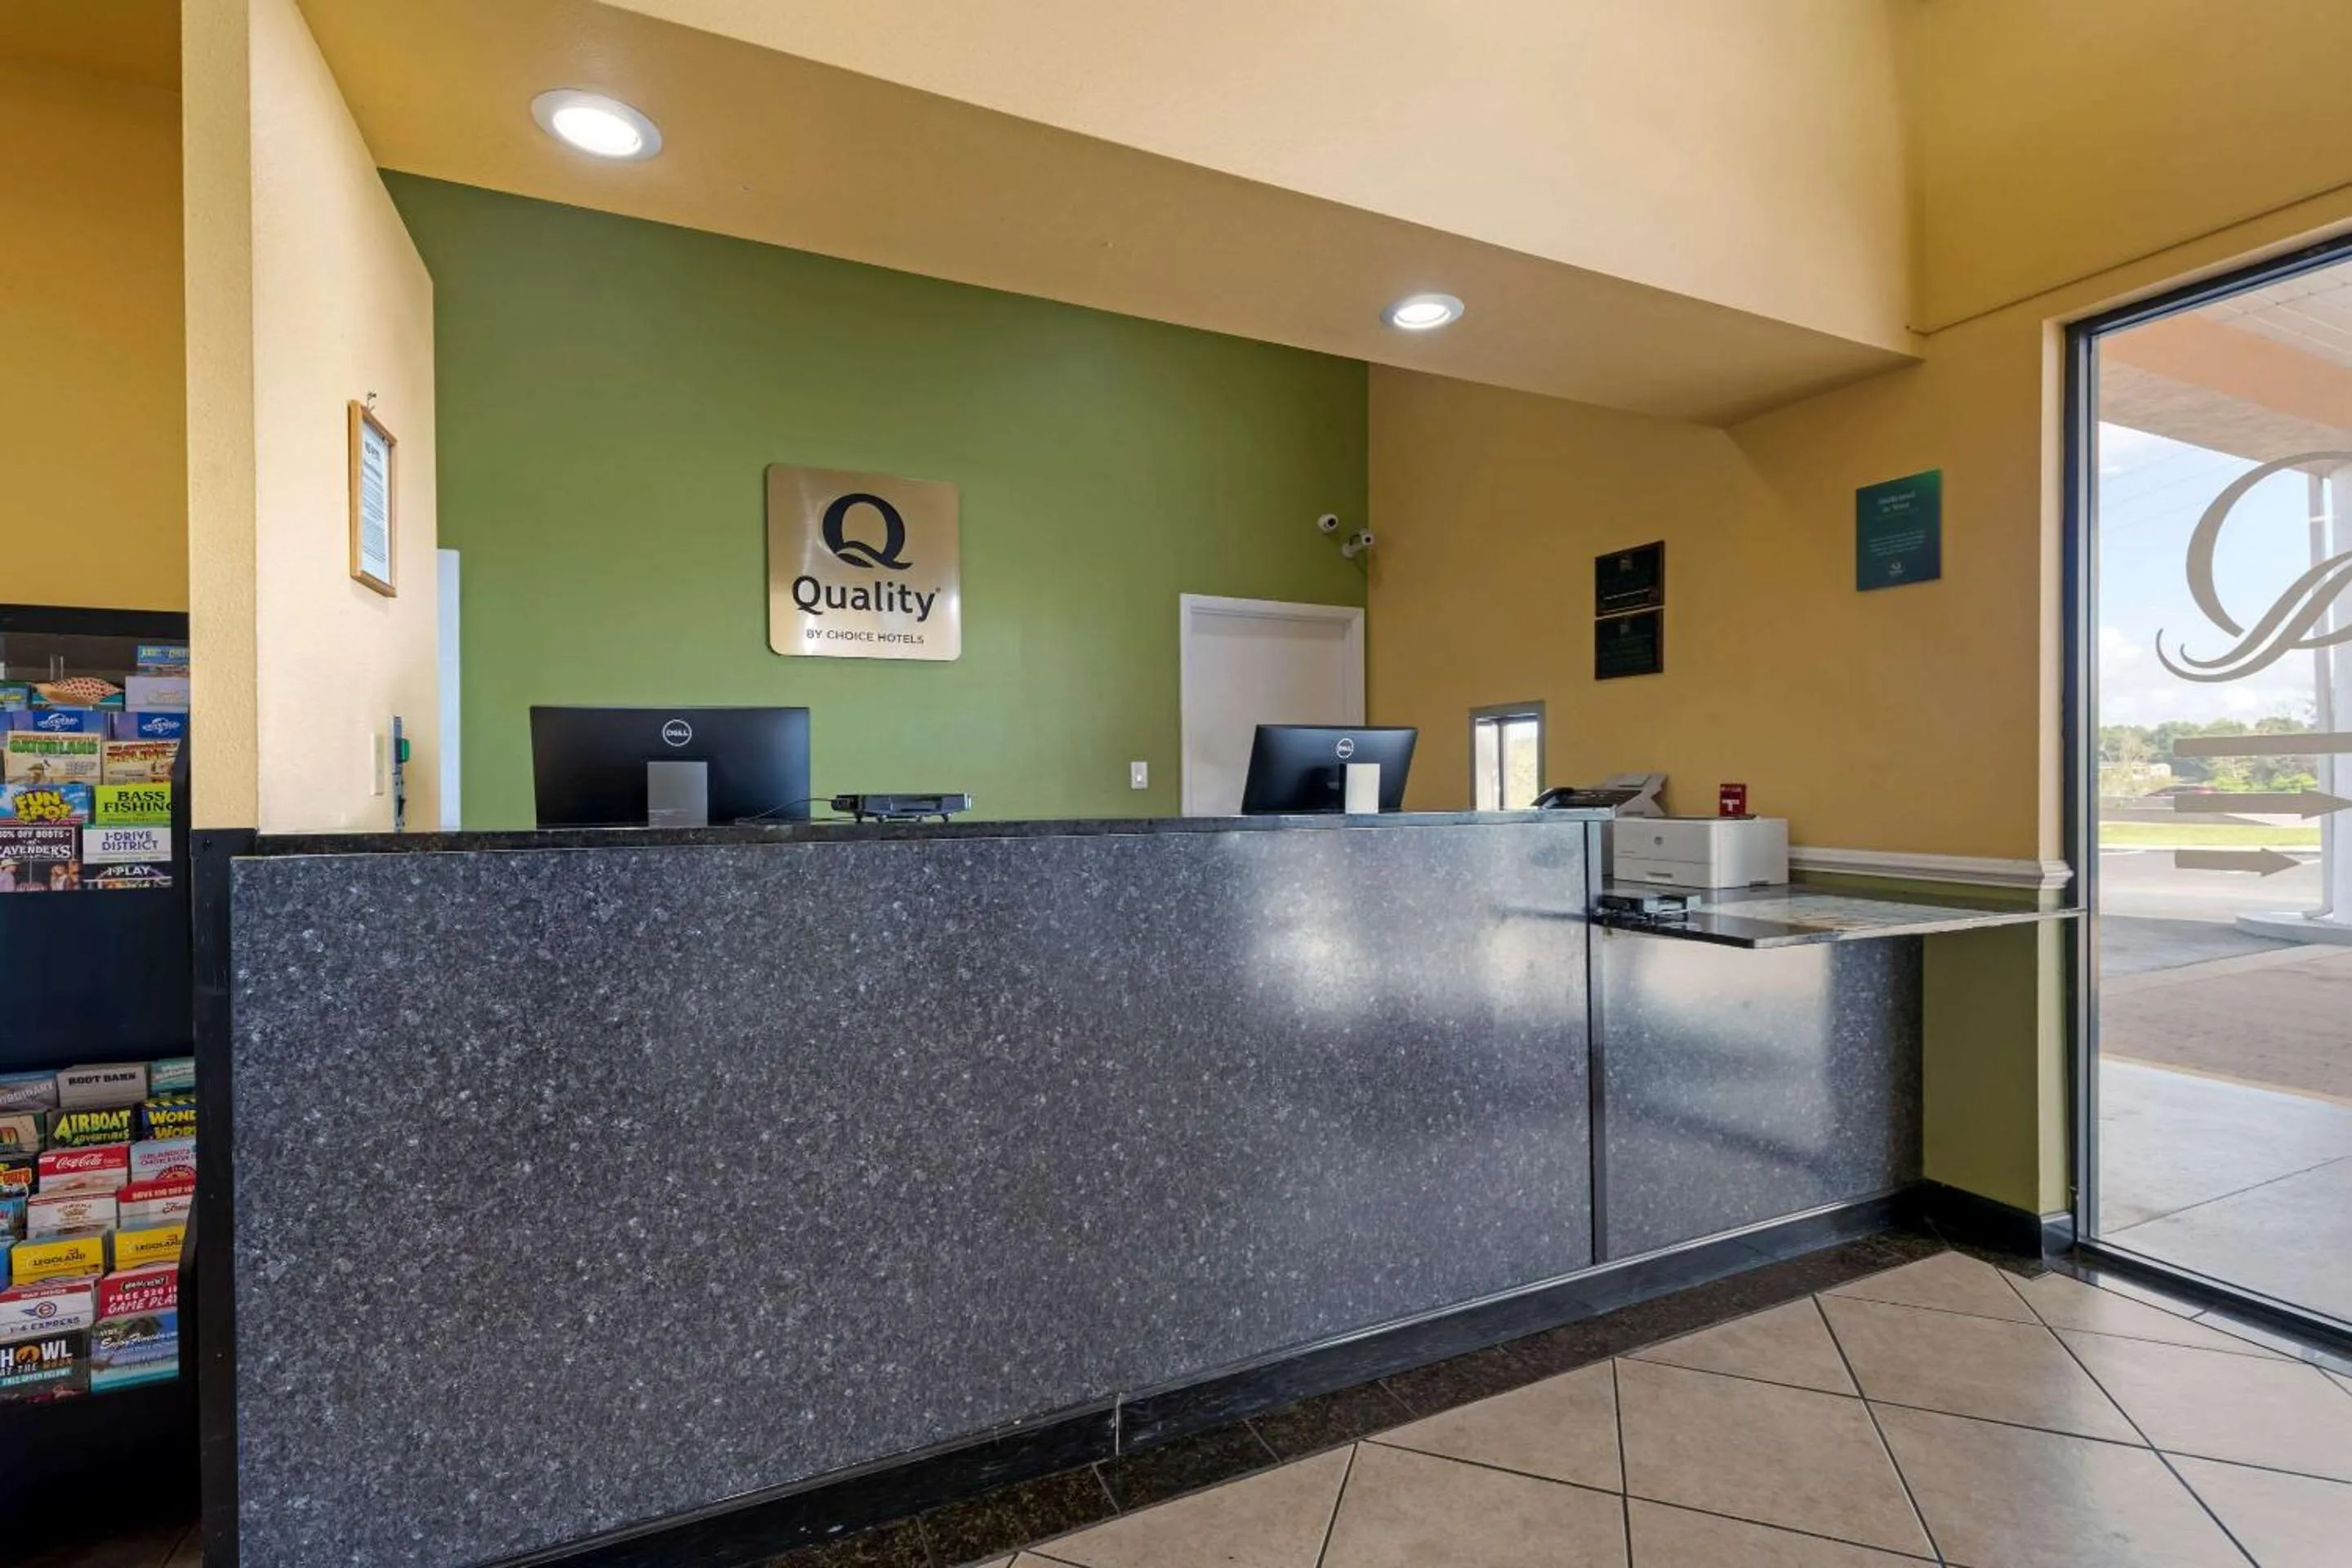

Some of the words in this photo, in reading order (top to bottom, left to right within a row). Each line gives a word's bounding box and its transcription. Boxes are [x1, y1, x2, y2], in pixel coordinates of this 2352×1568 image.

[822, 493, 913, 570] Q
[792, 575, 935, 622] Quality
[806, 629, 822, 639] BY
[826, 630, 874, 642] CHOICE
[878, 632, 924, 644] HOTELS
[14, 791, 61, 812] FUN
[117, 791, 165, 802] BASS
[105, 831, 153, 842] I-DRIVE
[0, 844, 71, 859] AVENDER'S
[101, 840, 159, 851] DISTRICT
[69, 1076, 100, 1085] BOOT
[103, 1072, 136, 1083] BARN
[53, 1109, 131, 1143] AIRBOAT
[109, 1291, 139, 1303] FREE
[108, 1298, 145, 1314] GAME
